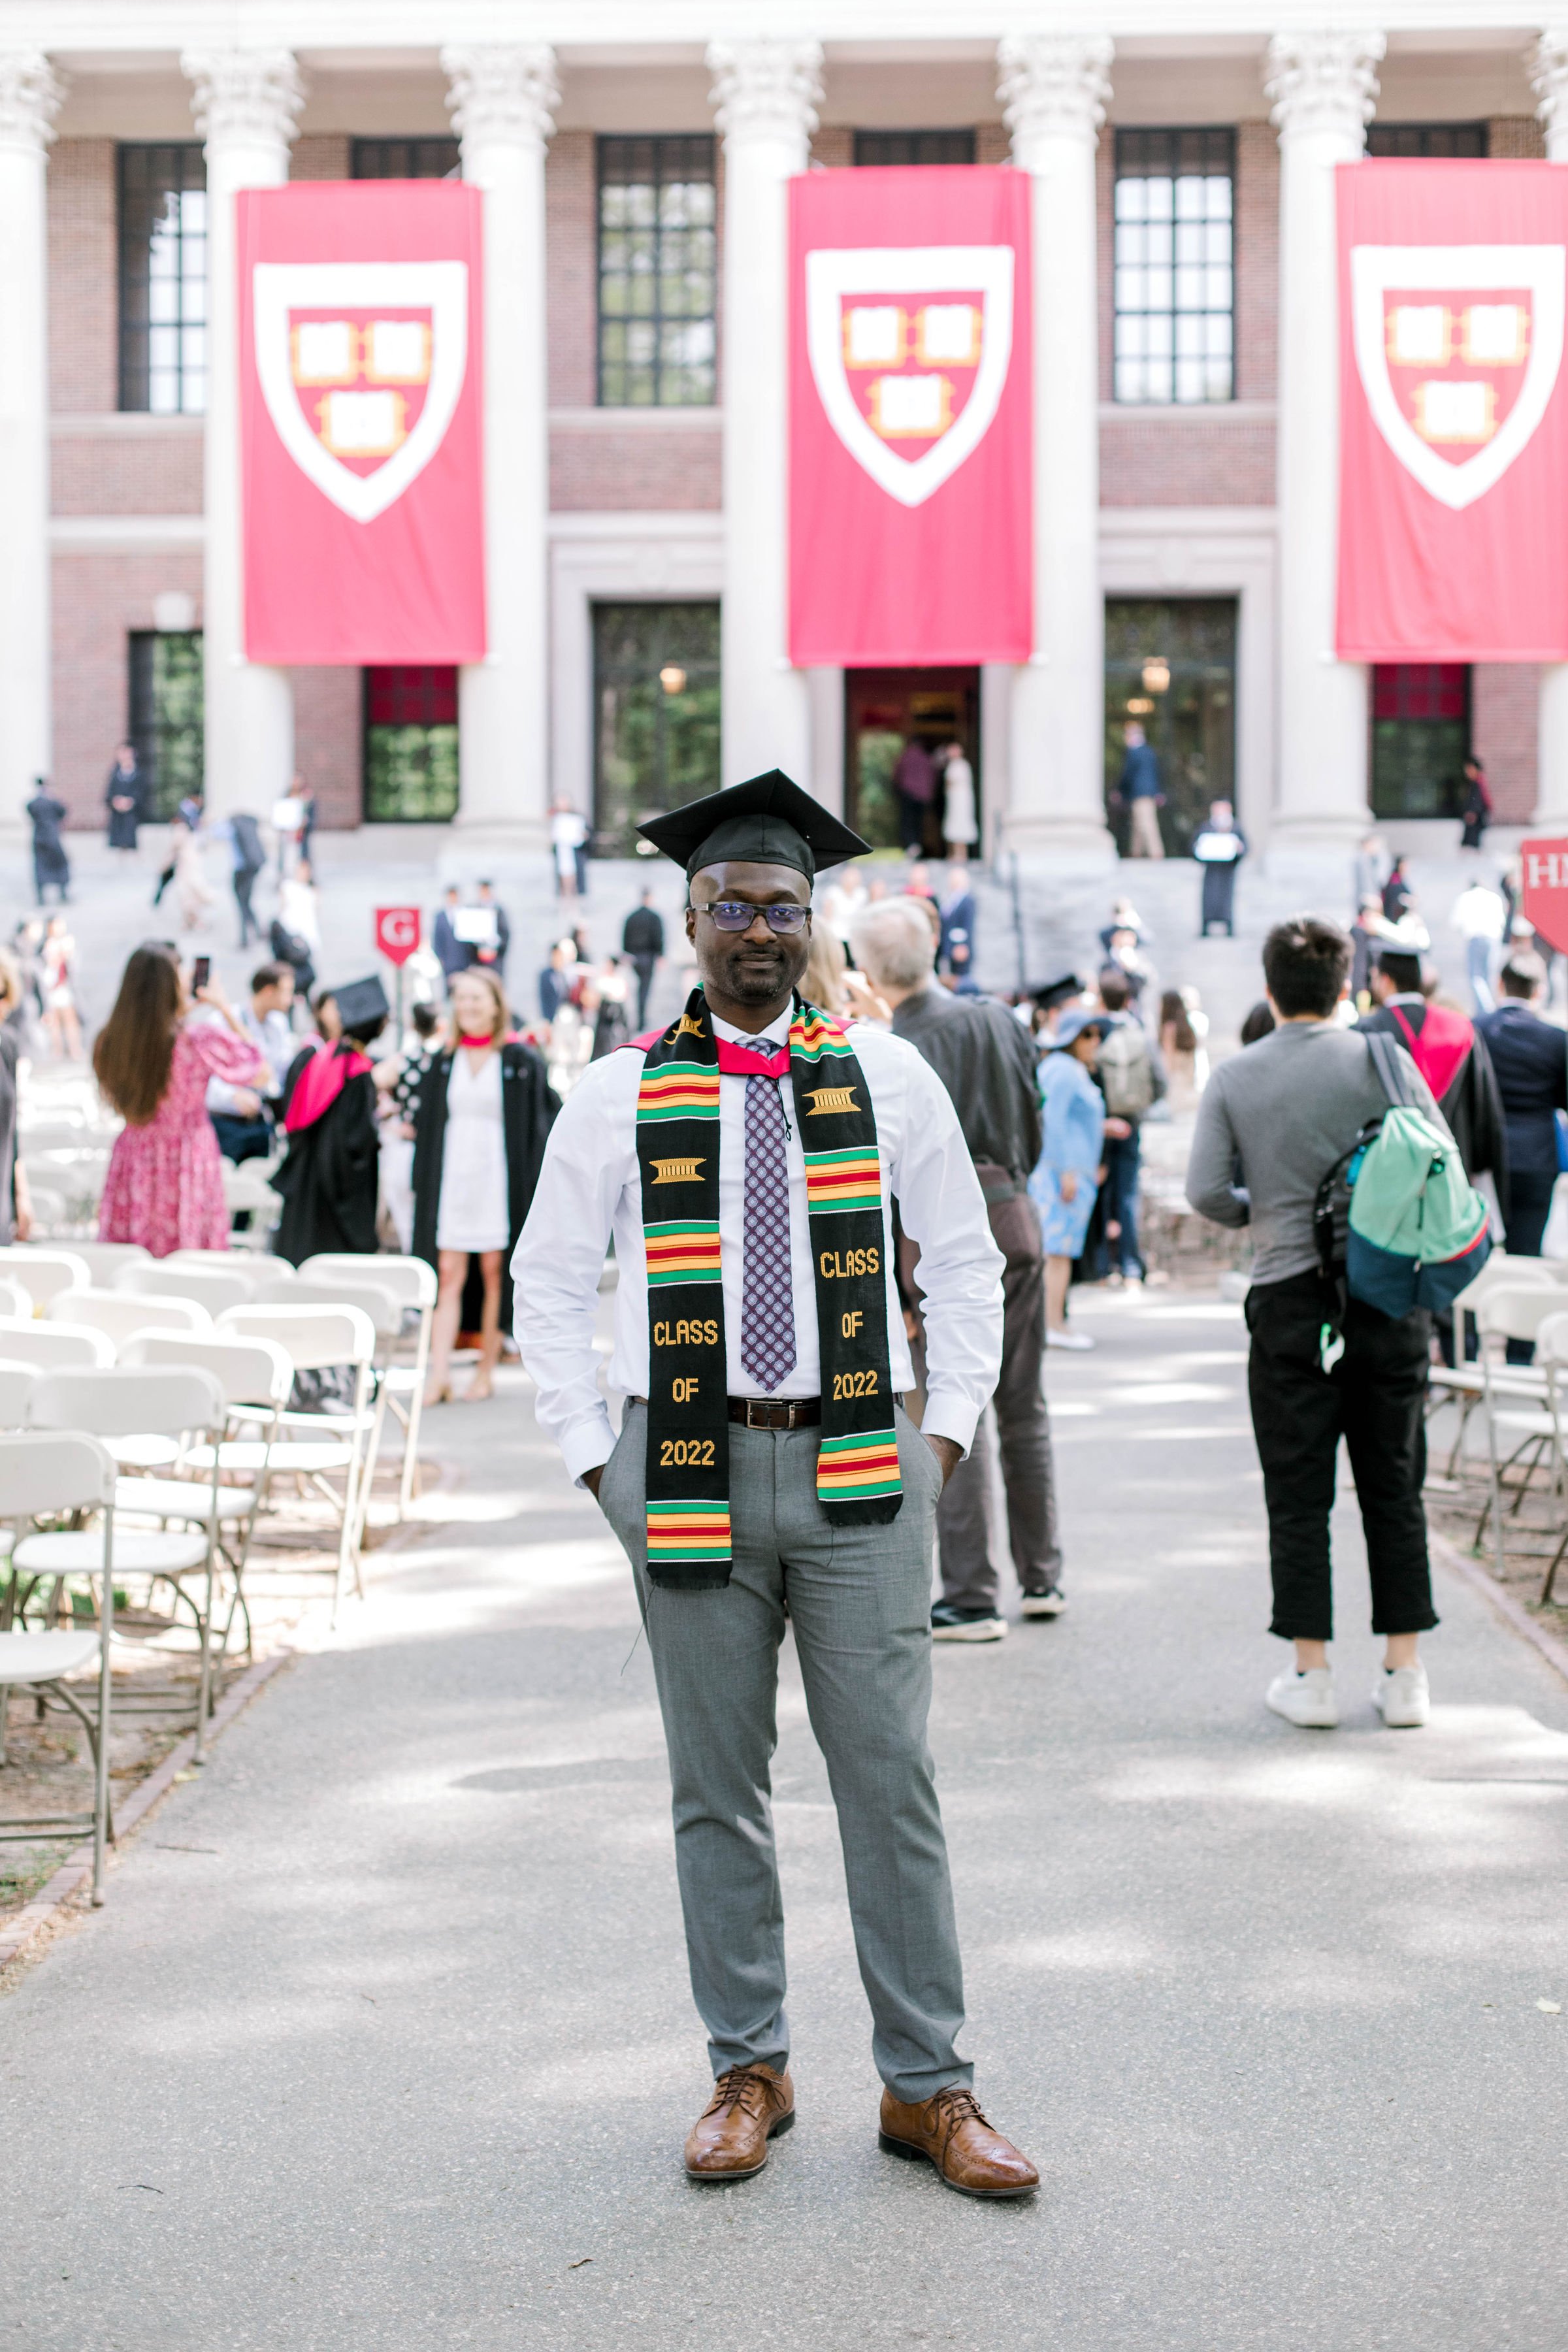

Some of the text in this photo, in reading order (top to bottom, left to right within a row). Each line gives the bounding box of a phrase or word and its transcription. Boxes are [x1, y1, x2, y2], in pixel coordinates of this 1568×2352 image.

[380, 909, 415, 947] G
[820, 1247, 879, 1279] CLASS
[654, 1319, 719, 1347] CLASS
[842, 1311, 863, 1339] OF
[673, 1378, 699, 1403] OF
[833, 1370, 879, 1401] 2022
[660, 1440, 715, 1466] 2022
